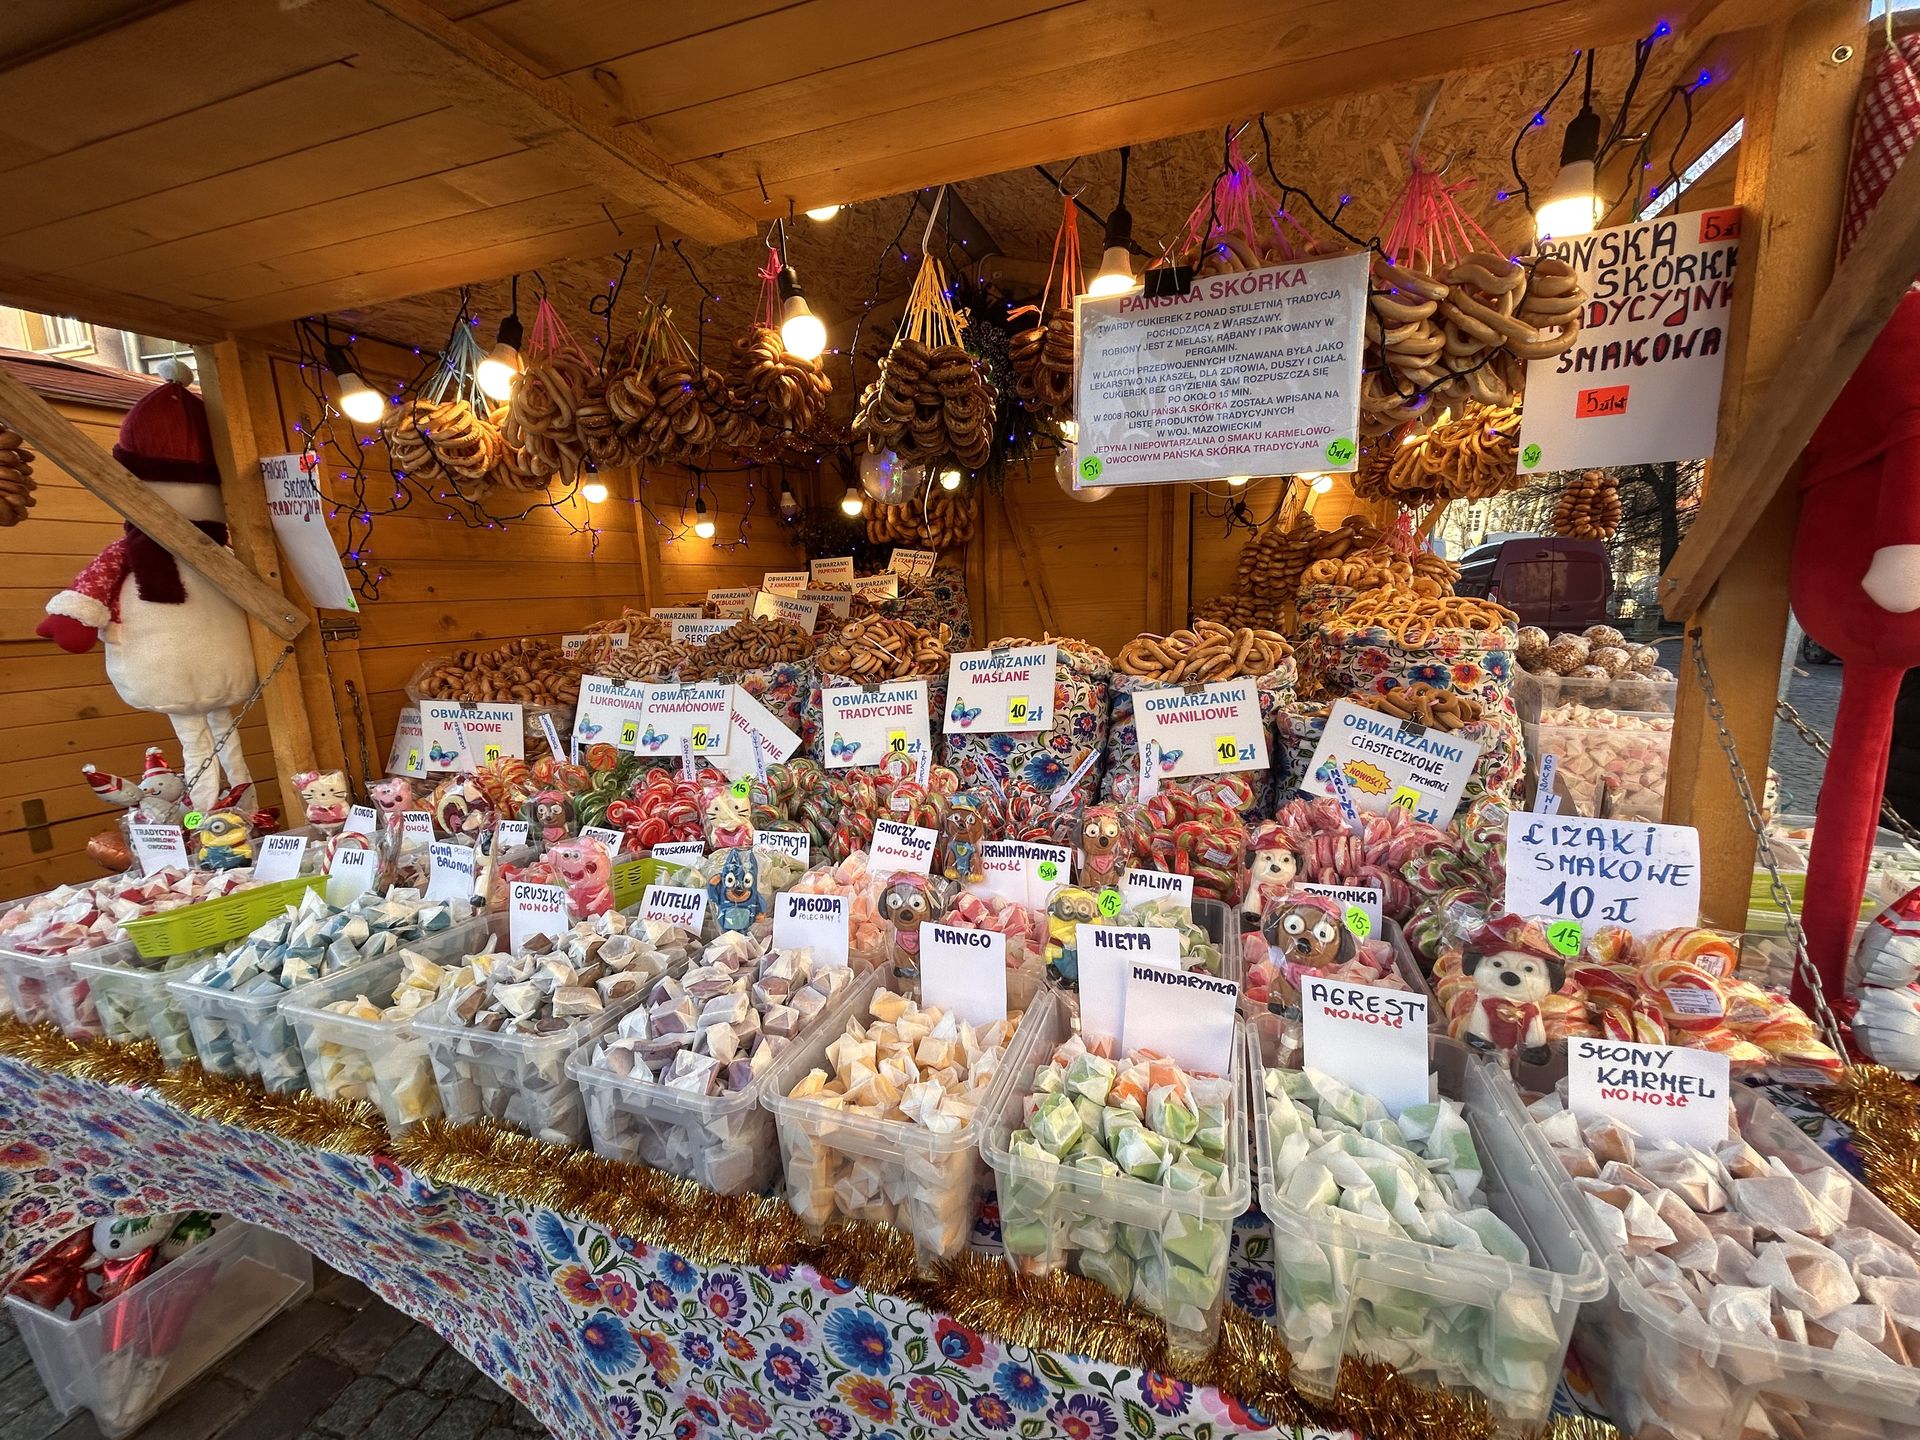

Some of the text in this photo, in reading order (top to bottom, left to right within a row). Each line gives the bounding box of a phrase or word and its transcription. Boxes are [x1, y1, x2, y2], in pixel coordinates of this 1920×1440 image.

[1210, 267, 1307, 299] SKÓRKA
[1098, 289, 1340, 332] TWARDY CUKIEREK Z PONAD STULETNIĄ TRADYCJĄ
[1102, 318, 1333, 356] ROBIONY JEST Z MELASY, RĄBANY I PAKOWANY W
[1146, 322, 1210, 340] POCHODZĄCĄ
[1213, 321, 1219, 329] Z
[1185, 342, 1237, 356] PERGAMIN.
[1556, 328, 1722, 373] SMAKOWA
[1093, 341, 1343, 379] W LATACH PRZEDWOJENNYCH UZNAWANA BYŁA JAKO
[1090, 352, 1346, 390] LEKARSTWO NA KASZEL, DLA ZDROWIA, DUSZY I CIAŁA.
[1102, 367, 1328, 399] CUKIEREK BEZ GRYZIENIA SAM ROZPUSZCZA SIĘ
[1168, 387, 1251, 403] PO OKOŁO 15 MIN.
[1124, 409, 1148, 418] ROKU
[1151, 404, 1186, 416] PAŃSKA
[1189, 399, 1227, 412] SKÓRKA
[1230, 396, 1273, 408] ZOSTAŁA
[1276, 391, 1321, 403] WPISANA
[1324, 390, 1338, 399] NA
[1128, 406, 1294, 430] LISTĘ PRODUKTÓW TRADYCYJNYCH
[1157, 421, 1261, 437] W WOJ. MAZOWIECKIM
[1093, 443, 1126, 453] JEDYNA
[1134, 436, 1215, 449] NIEPOWTARZALNA
[1218, 435, 1224, 443] O
[1227, 432, 1261, 442] SMAKU
[1264, 425, 1334, 439] KARMELOWO-
[1106, 440, 1318, 464] OWOCOWYM PAŃSKA SKÓRKA TRADYCYJNA
[815, 561, 850, 569] OBWARZANKI
[801, 594, 846, 602] OBWARZANKI
[960, 654, 1046, 671] OBWARZANKI
[971, 670, 1029, 684] MAŚLANE
[587, 682, 644, 699] OBWARZAN
[651, 690, 725, 701] OBWARZANKI
[831, 690, 918, 707] OBWARZANKI
[590, 695, 643, 711] LUKROWAN
[648, 702, 725, 713] CYNAMONOWE
[1145, 690, 1246, 711] OBWARZANKI
[430, 709, 513, 721] OBWARZANKI
[838, 704, 913, 720] TRADYCYJNE
[1011, 704, 1026, 718] 10
[1157, 706, 1239, 725] WANILIOWE
[623, 730, 635, 742] 10
[693, 732, 706, 746] 10
[1343, 713, 1463, 764] OBWARZANKI
[890, 738, 905, 752] 10
[1218, 743, 1236, 759] 10
[354, 807, 374, 819] KOKOS
[405, 823, 430, 833] OWOŚĆ
[877, 821, 916, 837] SMOCZY
[268, 836, 300, 851] WIŚNIA
[430, 844, 452, 858] GUMA
[654, 844, 703, 857] TRUSKAWKA
[901, 834, 932, 851] OWOC
[342, 850, 364, 866] KIWI
[877, 845, 923, 861] NOWOŚĆ
[983, 859, 1022, 872] OWOŚĆ
[1535, 852, 1694, 887] SMAKOWE
[1128, 872, 1182, 892] MALINA
[514, 884, 566, 905] GRUSZKA
[650, 889, 701, 911] NUTELLA
[1540, 881, 1639, 923] 10 zł
[789, 896, 842, 918] JAGODA
[646, 911, 694, 926] NOOŚĆ
[934, 928, 991, 949] MANGO
[1133, 966, 1238, 997] MANDARYNKA
[1311, 983, 1425, 1022] AGREST
[1324, 1006, 1404, 1029] NOWOŚĆ
[1578, 1042, 1673, 1069] SŁONY
[1597, 1066, 1716, 1099] KARMEL
[1601, 1087, 1689, 1108] NOWOŚĆ
